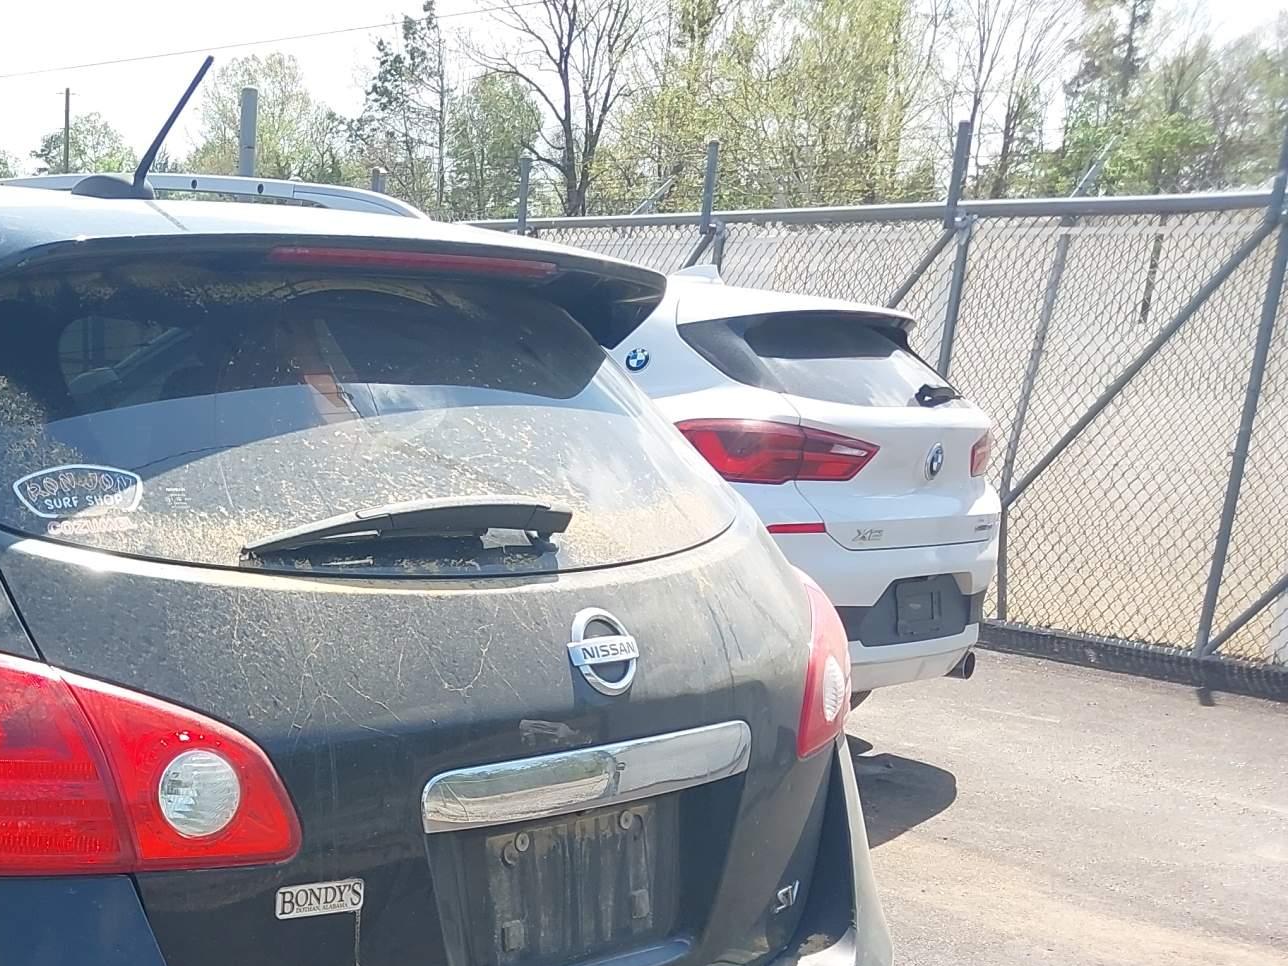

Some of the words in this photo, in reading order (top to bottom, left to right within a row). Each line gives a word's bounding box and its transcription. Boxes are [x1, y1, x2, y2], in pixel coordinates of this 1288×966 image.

[44, 496, 79, 510] SURF
[85, 494, 123, 506] SHOP
[47, 516, 138, 535] COZUMEL
[581, 641, 635, 660] NISSAN
[279, 882, 362, 916] BONDY'S
[775, 879, 800, 914] SV
